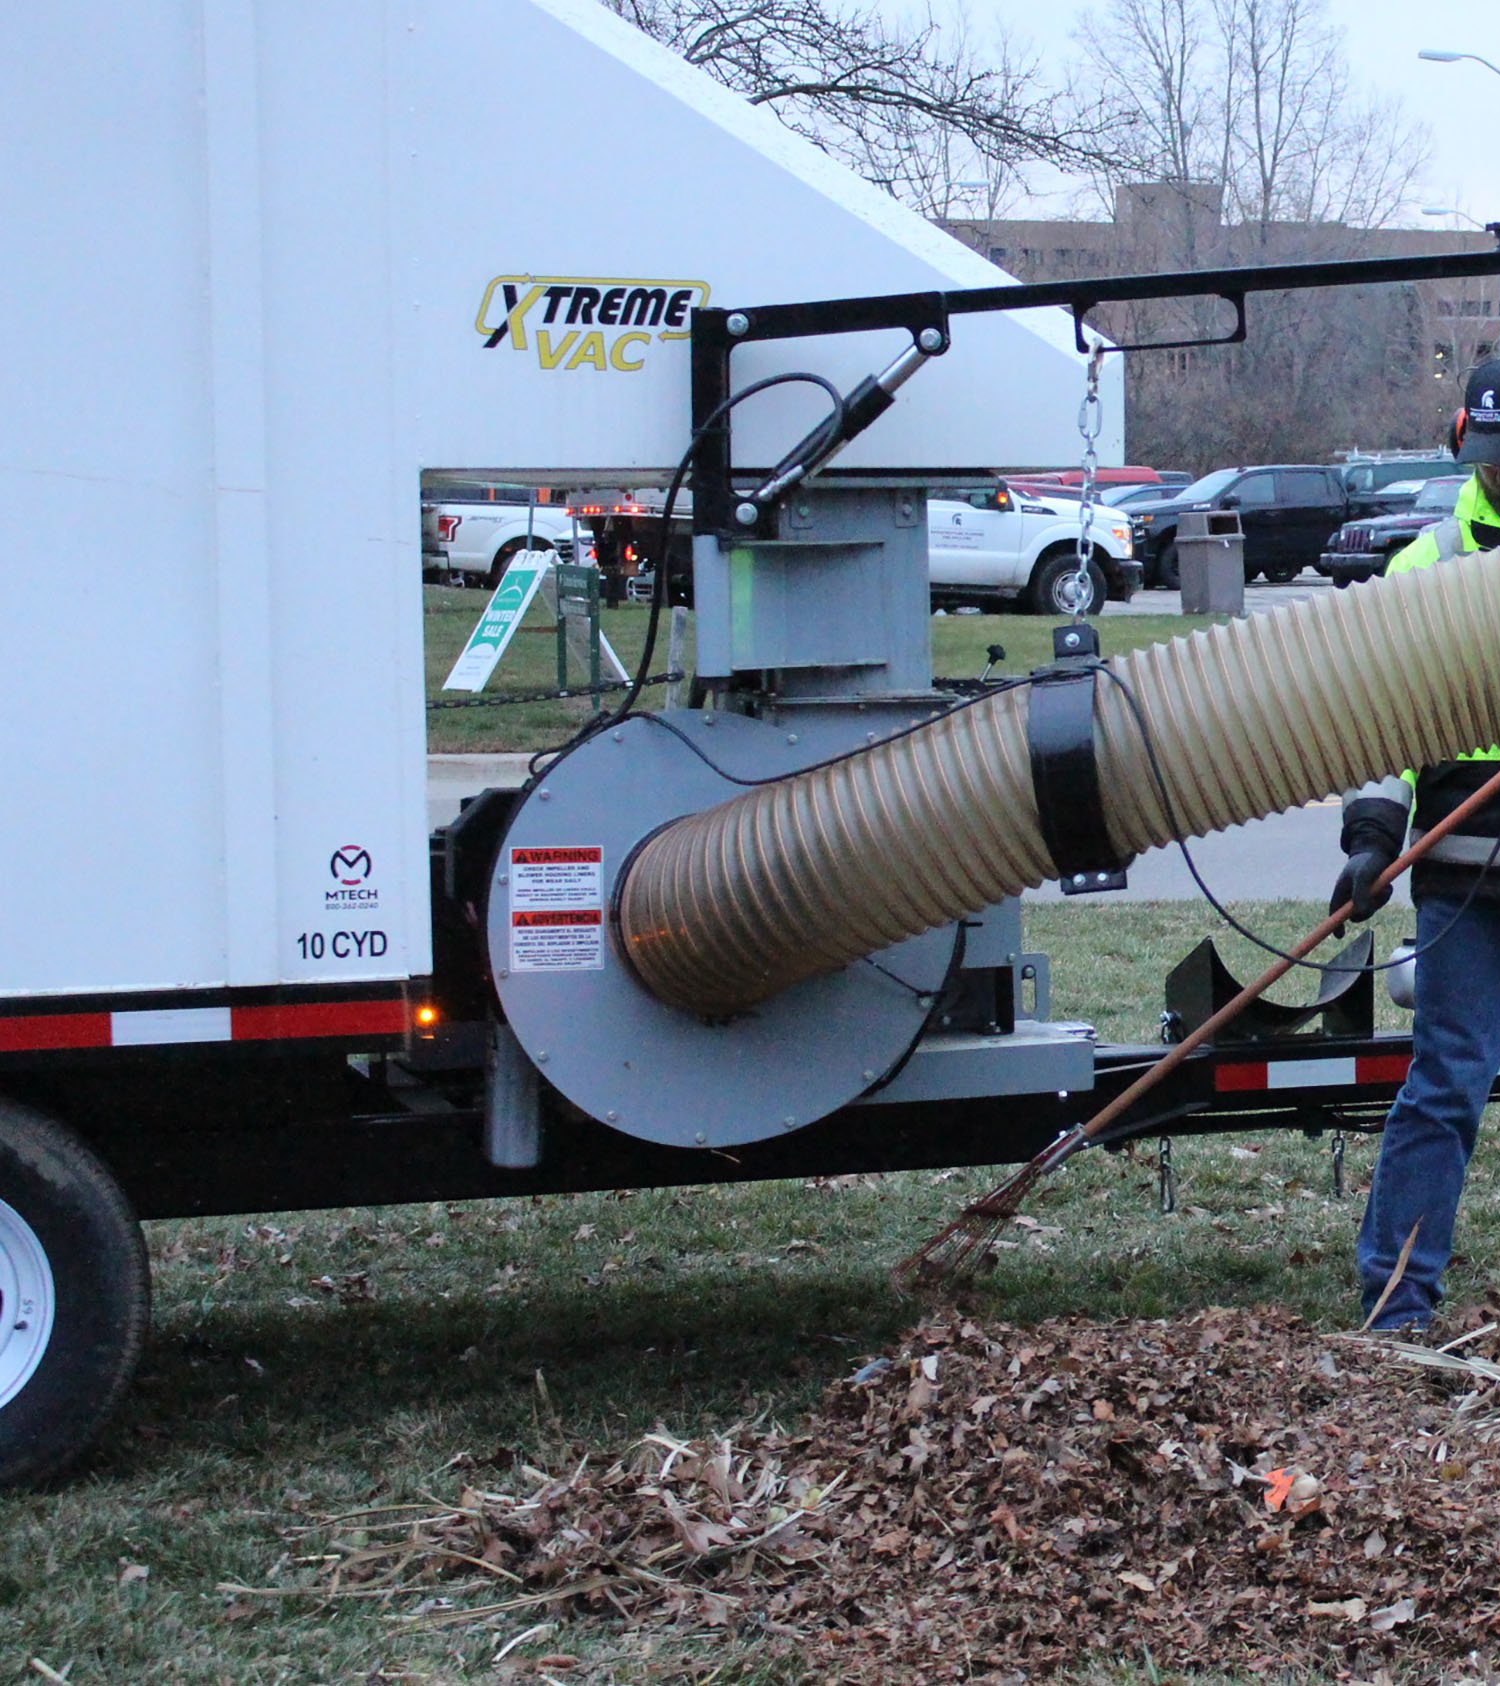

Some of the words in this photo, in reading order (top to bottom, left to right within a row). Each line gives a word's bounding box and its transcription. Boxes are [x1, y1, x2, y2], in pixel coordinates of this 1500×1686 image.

[483, 285, 692, 350] XTREME
[536, 330, 651, 371] VAC
[485, 609, 516, 623] WINTER
[482, 625, 504, 637] SALE
[530, 850, 599, 862] WARNING
[325, 889, 378, 901] MTECH
[297, 932, 325, 959] 10
[332, 930, 388, 958] CYD
